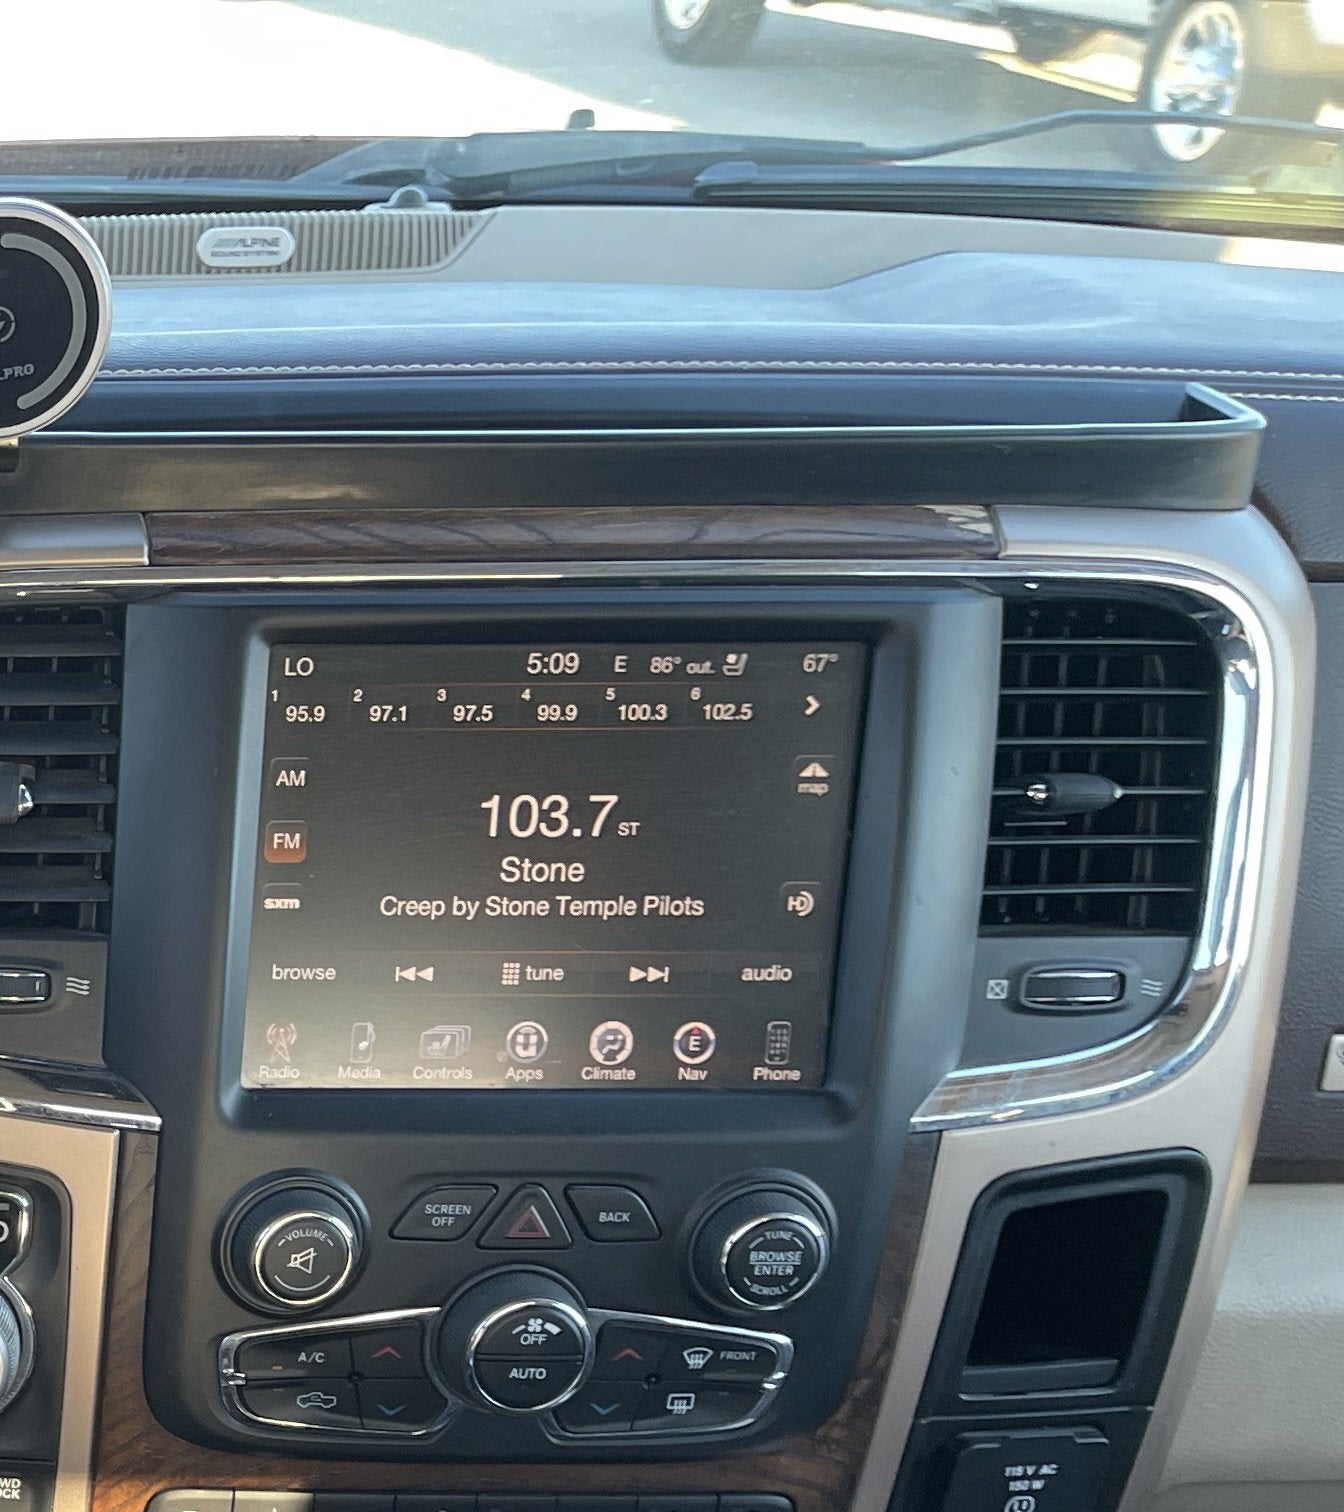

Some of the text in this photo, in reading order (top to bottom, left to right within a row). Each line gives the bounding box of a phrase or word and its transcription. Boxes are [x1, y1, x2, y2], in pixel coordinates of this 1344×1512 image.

[283, 656, 314, 677] LO
[526, 652, 580, 675] 5:09
[613, 655, 629, 673] E
[271, 689, 279, 702] 1
[352, 689, 363, 702] 2
[436, 689, 447, 702] 3
[520, 688, 531, 701] 4
[605, 687, 616, 701] 5
[690, 687, 702, 701] 6
[285, 705, 326, 723] 95.9
[369, 705, 408, 722] 97.1
[452, 704, 493, 722] 97.5
[536, 704, 579, 721] 99.9
[617, 703, 668, 721] 100.3
[702, 703, 753, 721] 102.5
[275, 769, 306, 787] AM
[480, 794, 641, 839] 103.7 ST
[272, 833, 301, 850] FM
[499, 855, 585, 883] Stone
[380, 895, 705, 921] Creep by Stone Temple Pilots
[271, 964, 337, 981] browse
[525, 965, 565, 981] tune
[741, 964, 793, 982] audio
[258, 1066, 300, 1079] Radio
[338, 1066, 381, 1079] Media
[412, 1066, 473, 1080] Controls
[505, 1067, 543, 1082] Apps
[581, 1067, 636, 1081] Climate
[677, 1067, 708, 1081] Nav
[752, 1067, 801, 1081] Phone
[424, 1203, 472, 1215] SCREEN
[431, 1216, 456, 1228] OFF
[598, 1211, 631, 1223] BACK
[285, 1228, 329, 1243] VOLUME
[764, 1230, 794, 1241] TUNE
[749, 1251, 803, 1264] BROWSE
[753, 1264, 795, 1276] ENTER
[749, 1283, 789, 1297] SCROLL
[520, 1333, 548, 1345] OFF
[297, 1351, 326, 1363] A/C
[719, 1351, 757, 1361] FRONT
[508, 1367, 547, 1380] AUTO
